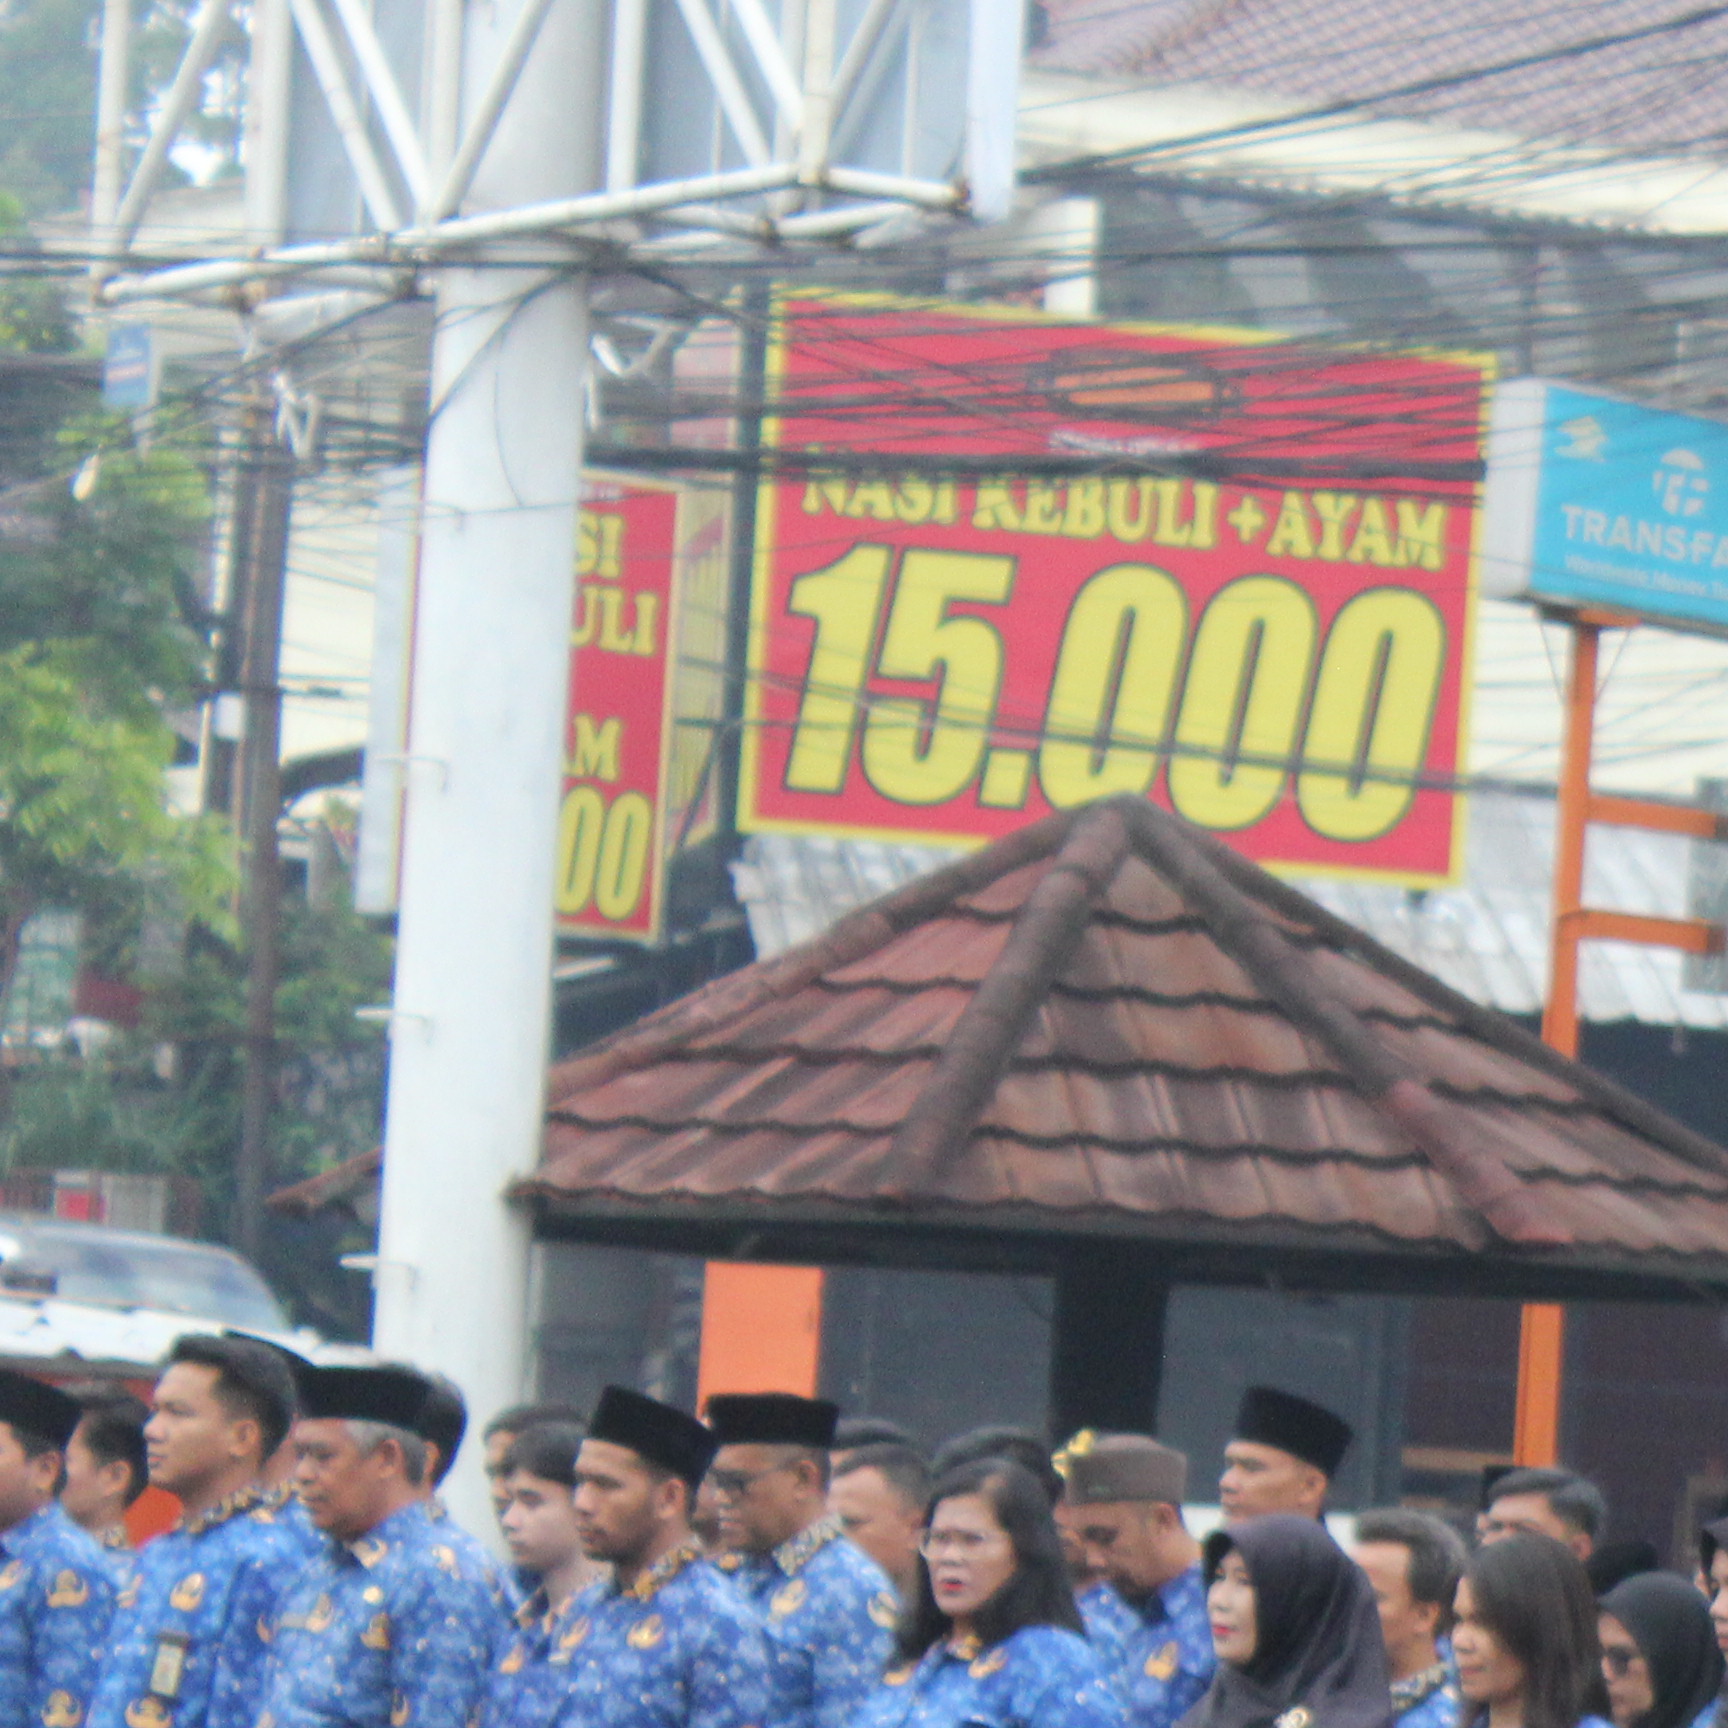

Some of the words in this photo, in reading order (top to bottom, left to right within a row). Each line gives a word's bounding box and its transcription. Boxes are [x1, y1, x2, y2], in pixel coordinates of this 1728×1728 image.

[970, 462, 1218, 550] KEBULI
[1265, 489, 1447, 571] AYAM
[788, 542, 1447, 844] 15.000
